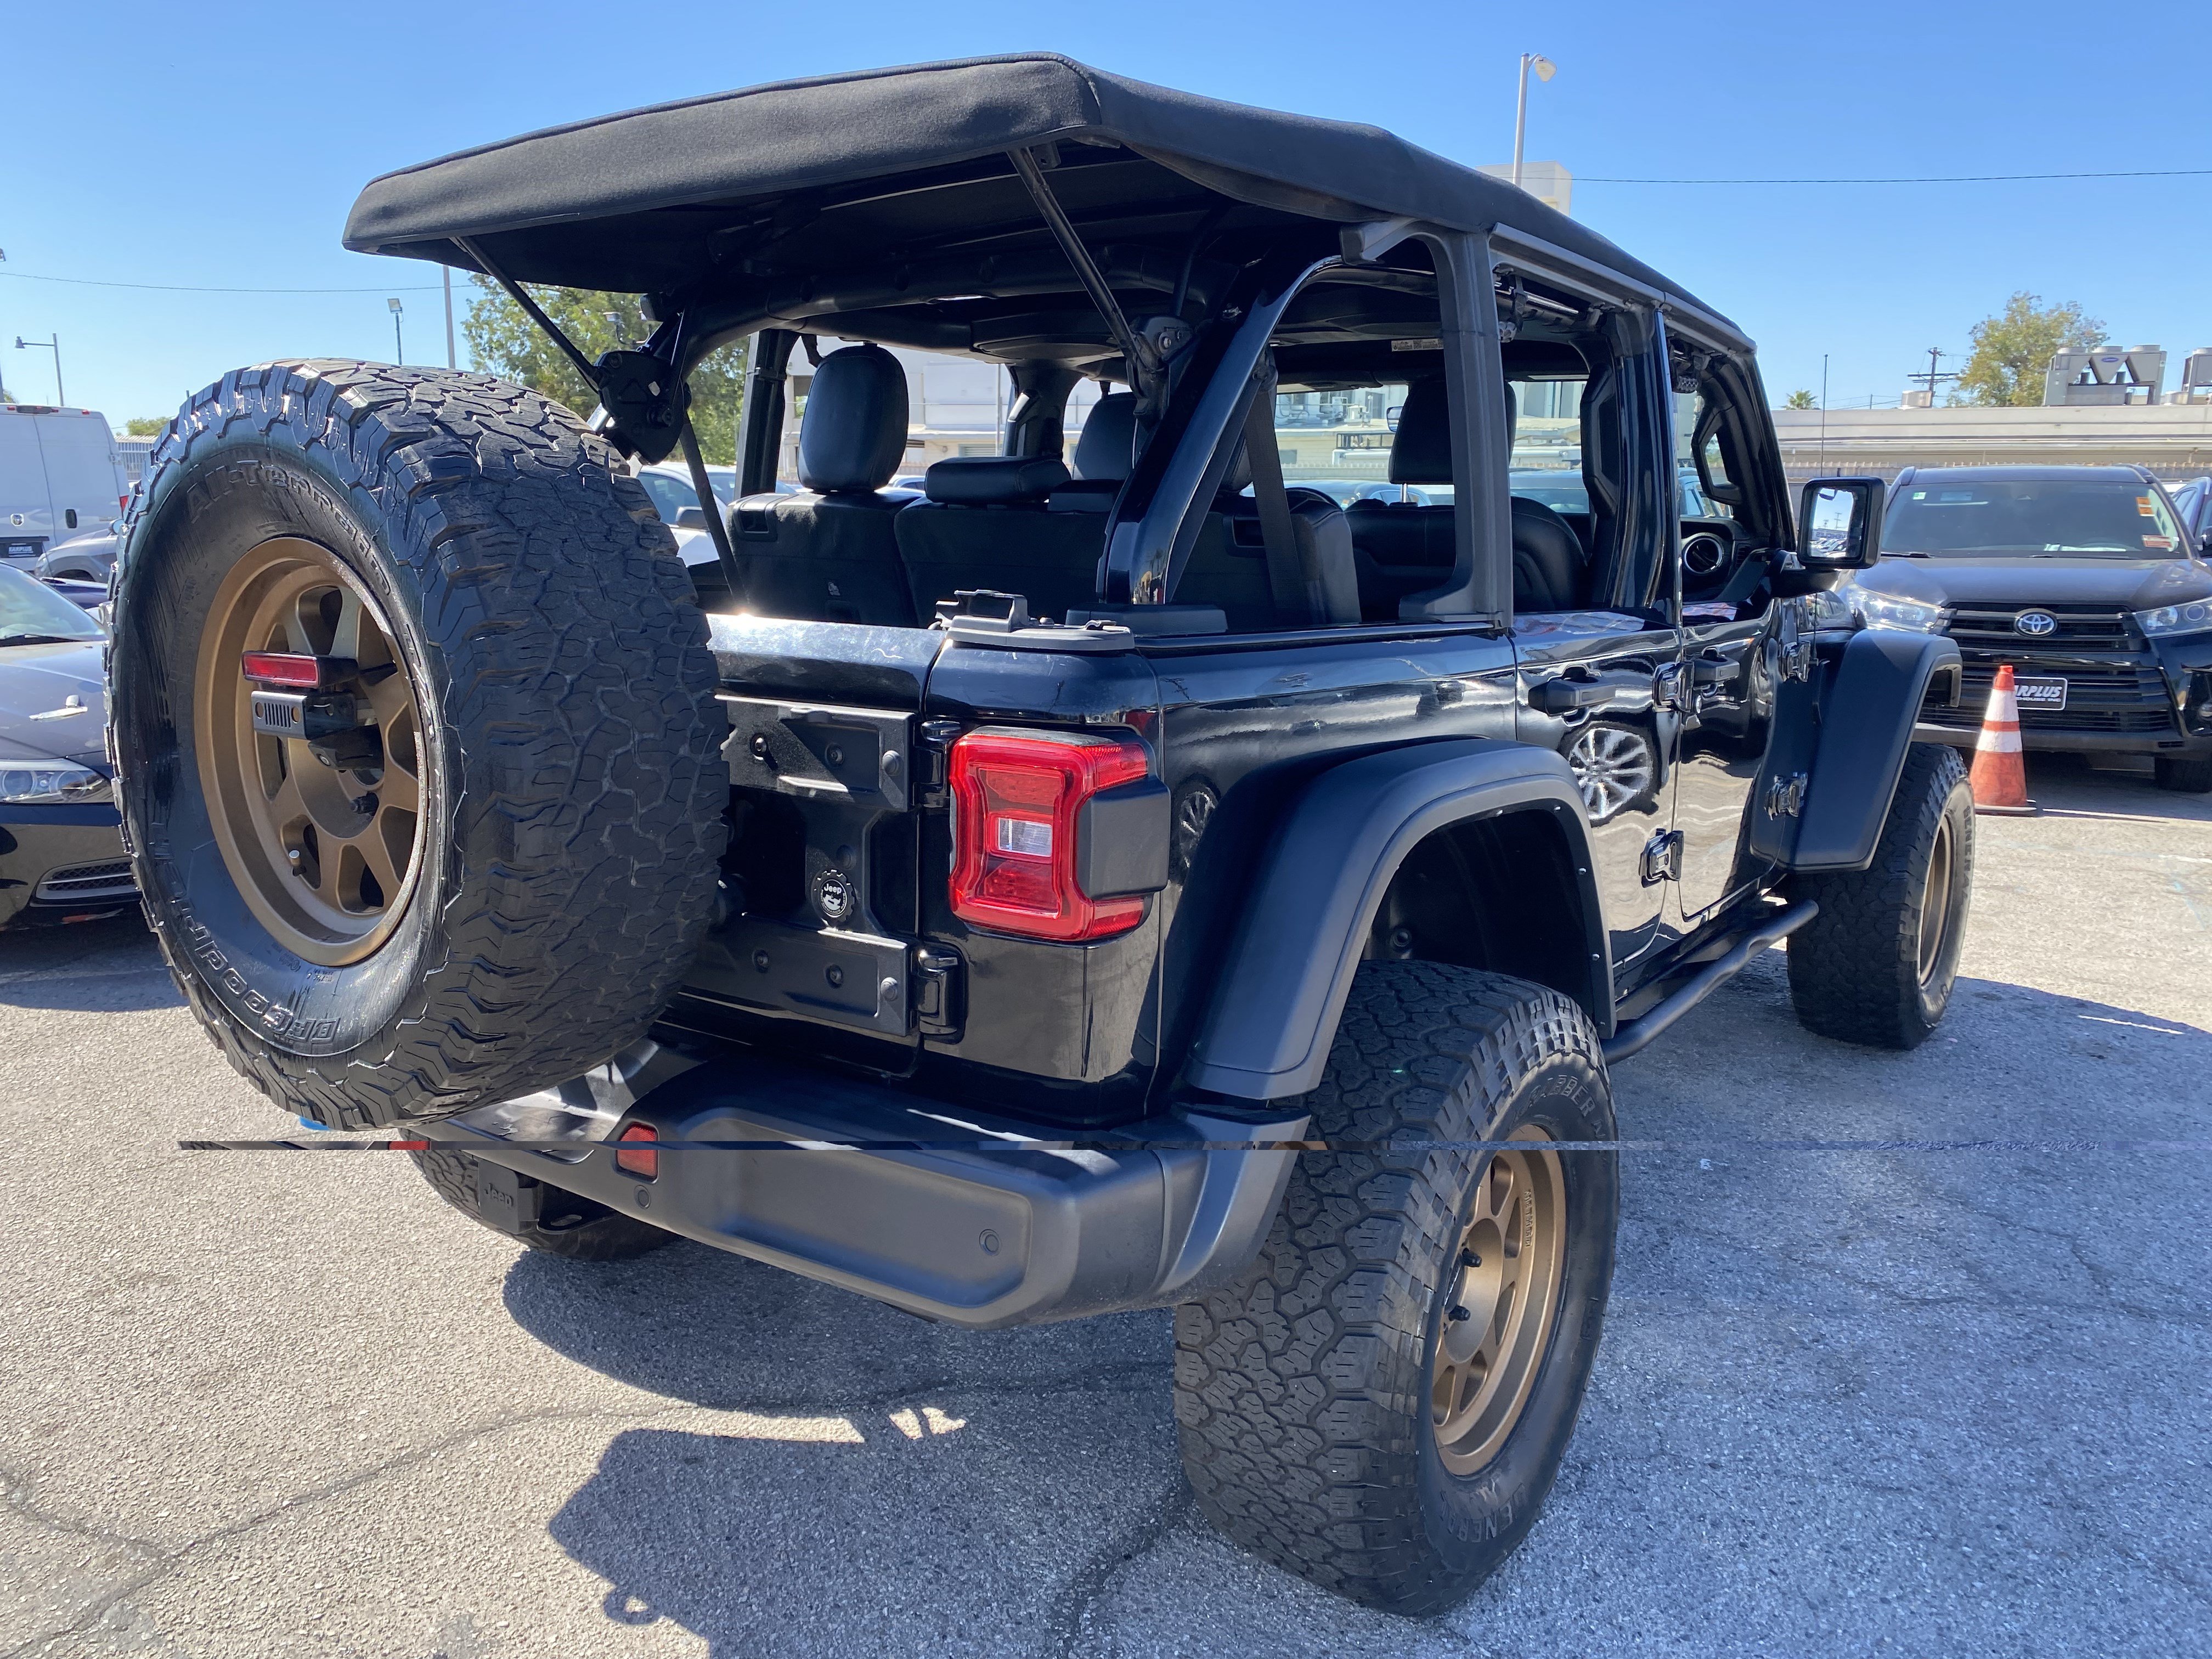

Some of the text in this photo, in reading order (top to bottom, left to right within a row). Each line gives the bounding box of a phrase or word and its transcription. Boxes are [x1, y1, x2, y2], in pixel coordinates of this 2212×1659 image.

[187, 460, 391, 596] All-Terrain
[823, 883, 842, 895] Jeep
[483, 1182, 514, 1209] Jeep
